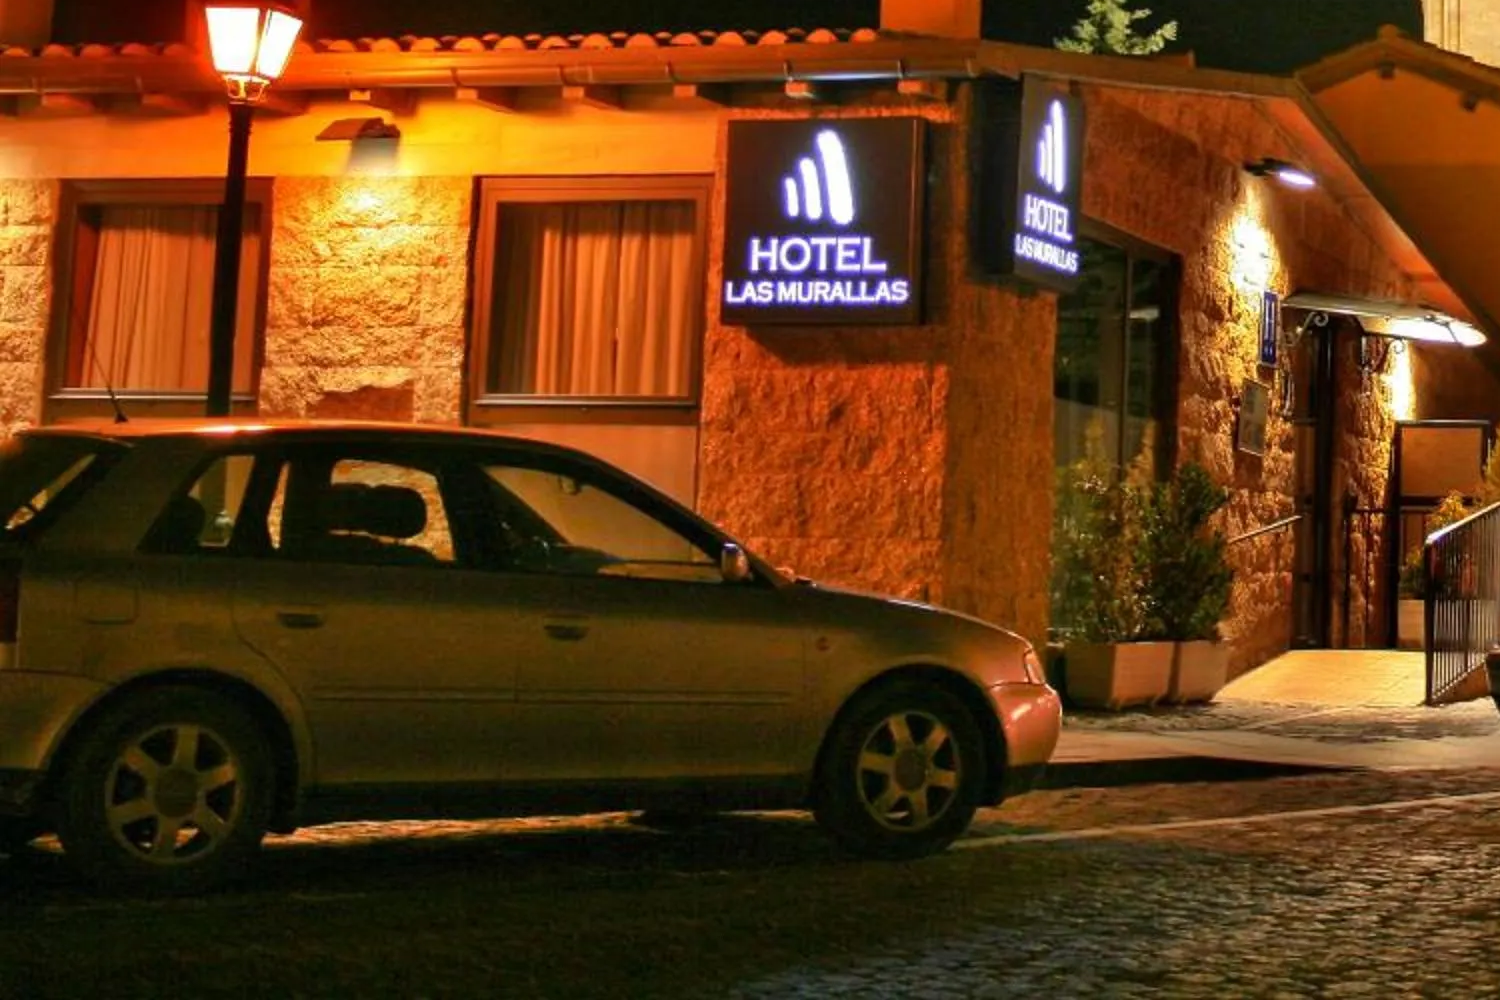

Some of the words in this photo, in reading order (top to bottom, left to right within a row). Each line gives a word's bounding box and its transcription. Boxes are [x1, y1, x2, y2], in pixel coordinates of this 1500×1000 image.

[1024, 193, 1073, 242] HOTEL
[750, 236, 888, 273] HOTEL
[1014, 233, 1034, 258] LAS
[1033, 239, 1079, 273] MURALLAS
[725, 280, 774, 304] LAS
[777, 280, 910, 304] MURALLAS
